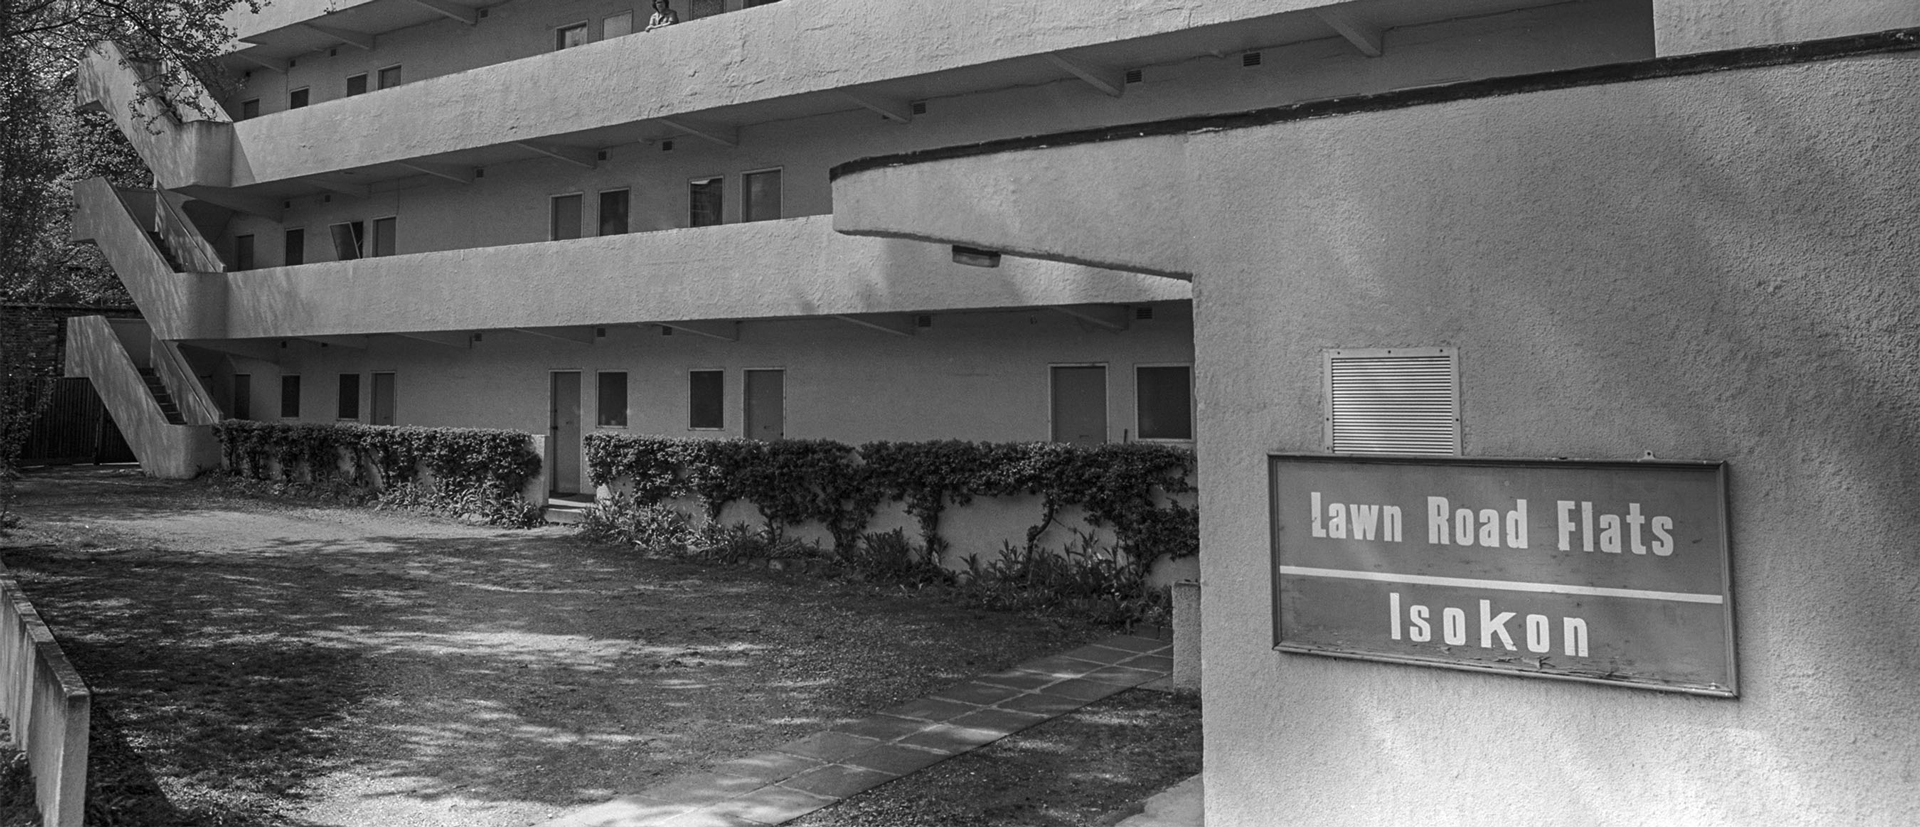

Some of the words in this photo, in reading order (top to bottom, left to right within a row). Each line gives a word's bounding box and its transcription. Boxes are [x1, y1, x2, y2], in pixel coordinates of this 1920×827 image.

[1311, 491, 1402, 542] Lawn
[1427, 496, 1529, 549] Road
[1557, 500, 1674, 557] Flats
[1389, 592, 1589, 657] Isokon
